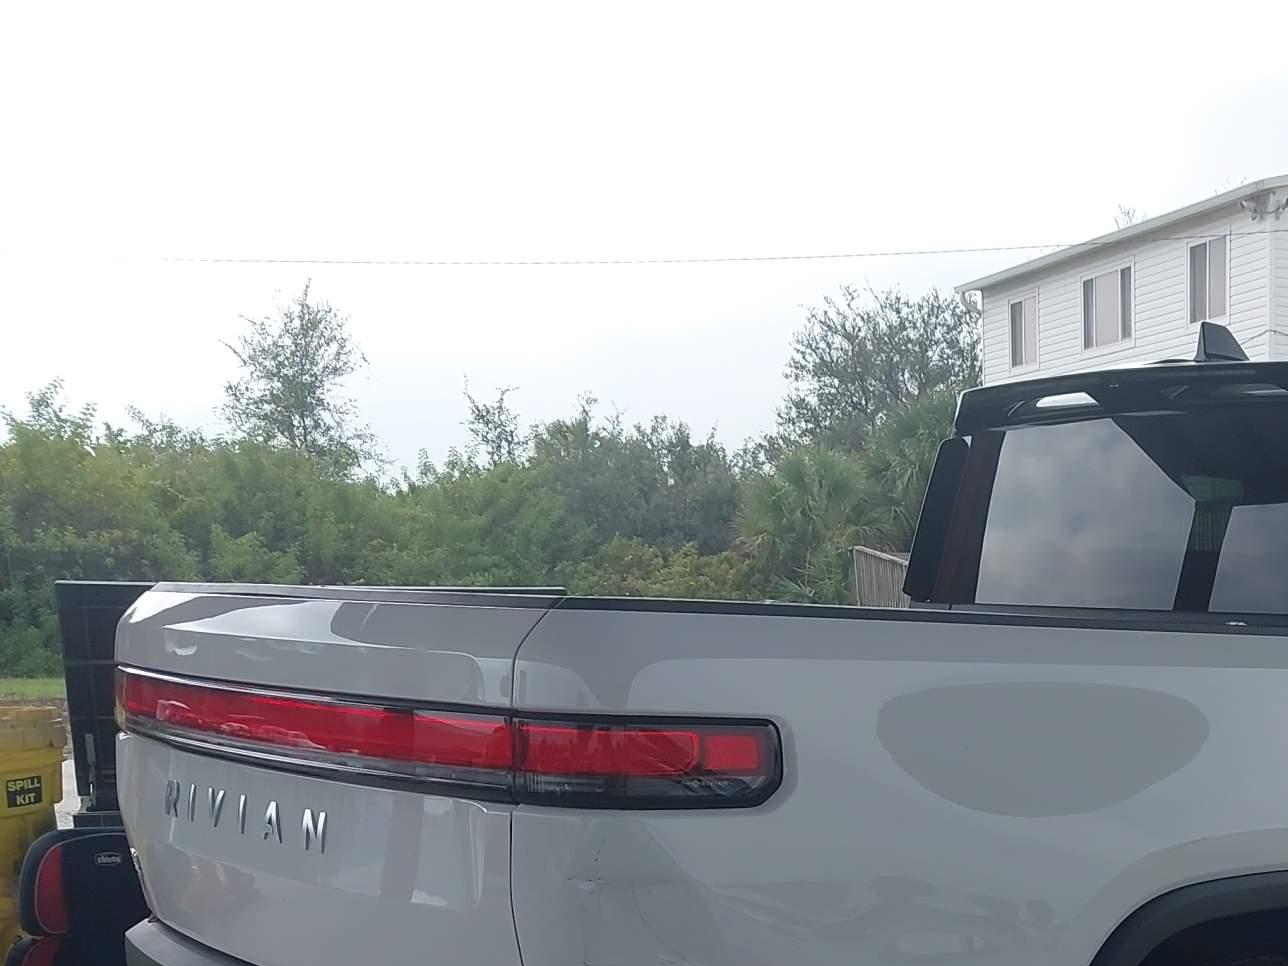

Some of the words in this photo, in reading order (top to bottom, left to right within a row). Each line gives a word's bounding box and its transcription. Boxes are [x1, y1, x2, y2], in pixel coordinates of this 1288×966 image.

[7, 777, 41, 791] SPILL
[16, 793, 36, 806] KIT
[165, 779, 328, 854] RIVIAN
